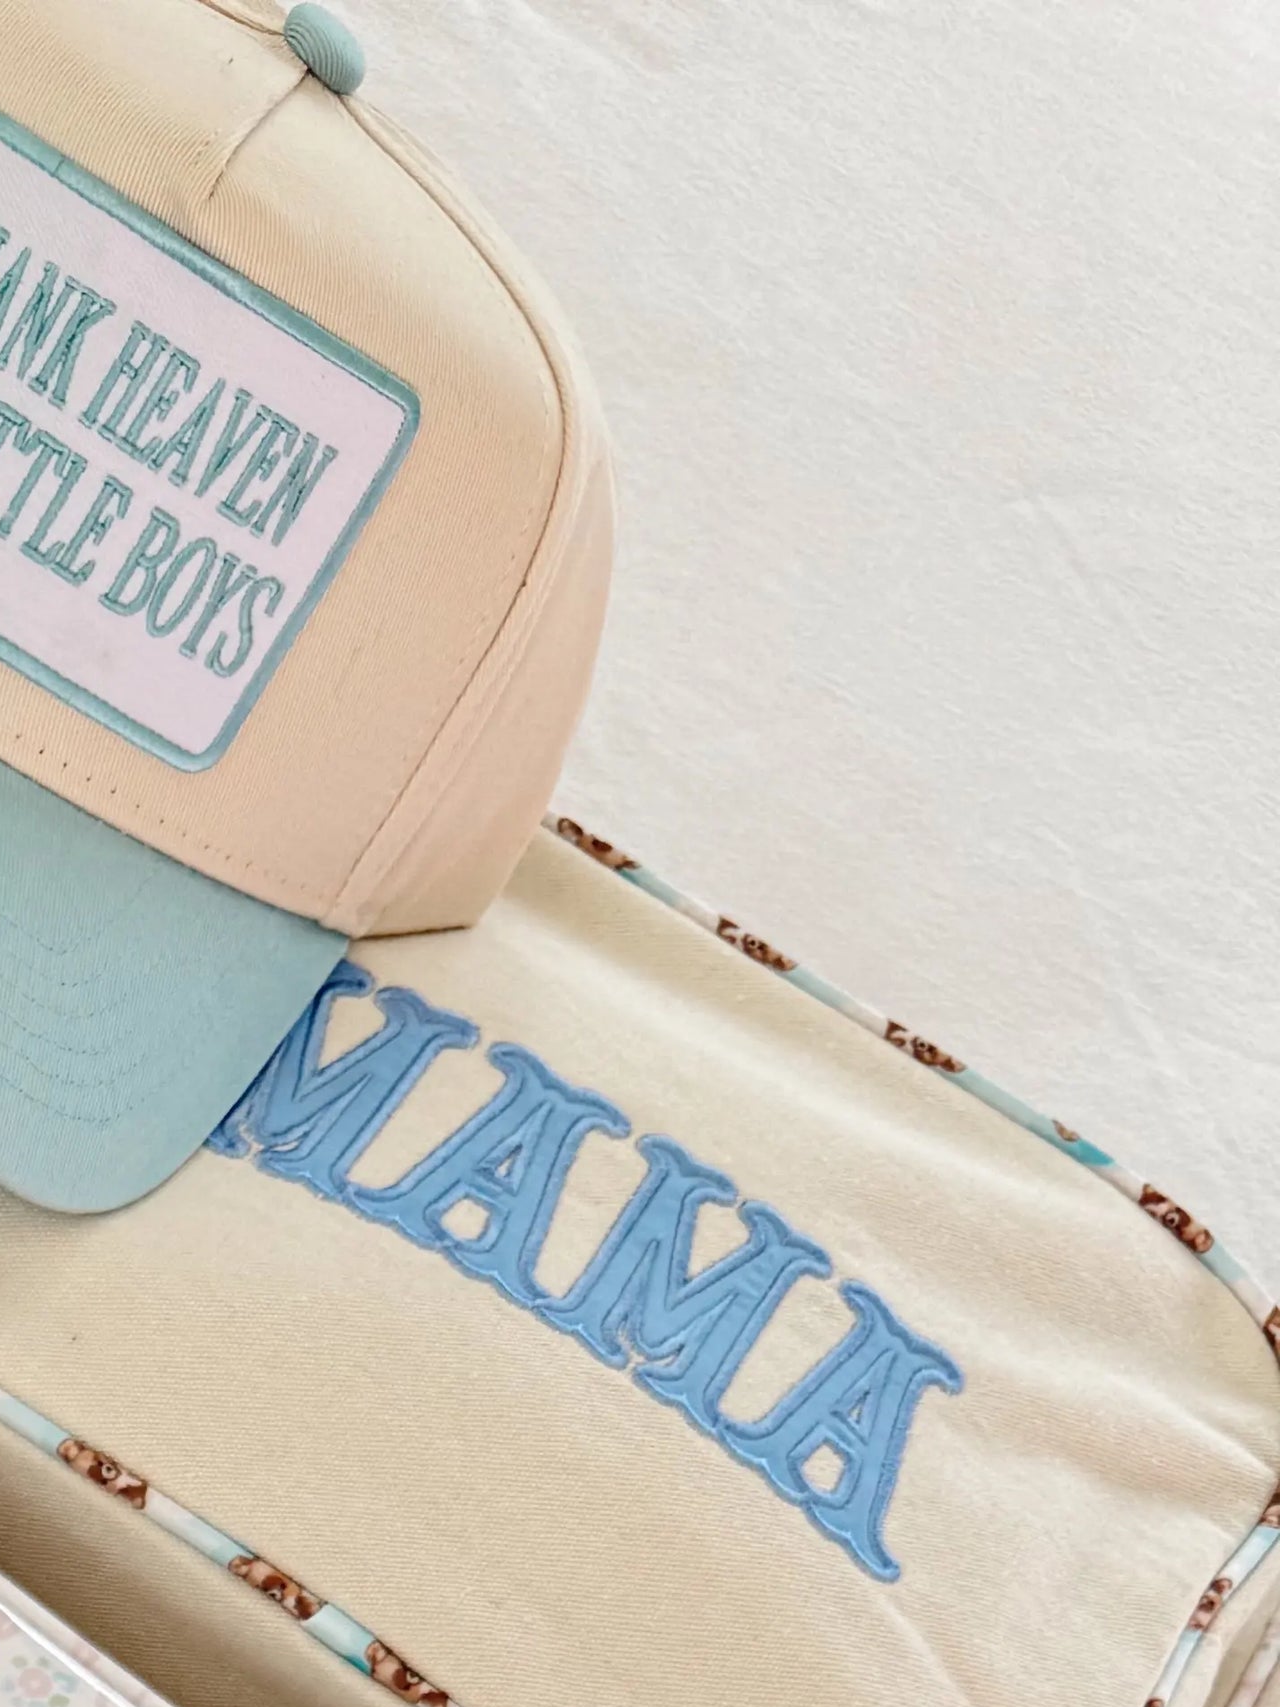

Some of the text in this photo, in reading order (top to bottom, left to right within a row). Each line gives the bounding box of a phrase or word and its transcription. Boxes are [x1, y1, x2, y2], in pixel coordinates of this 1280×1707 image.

[82, 318, 338, 548] HEAVEN
[98, 506, 288, 679] BOYS
[204, 958, 965, 1583] MAMA
